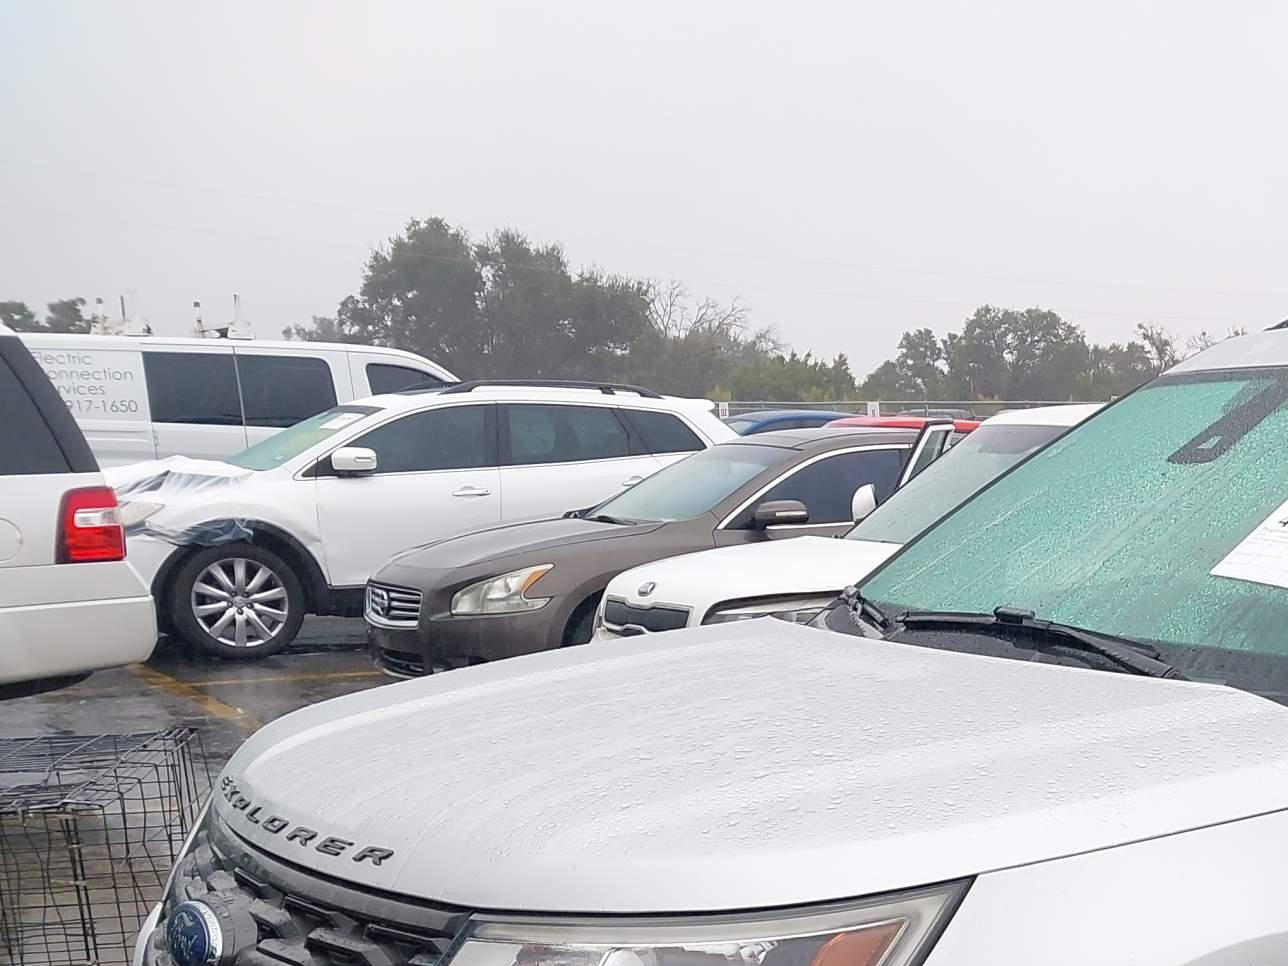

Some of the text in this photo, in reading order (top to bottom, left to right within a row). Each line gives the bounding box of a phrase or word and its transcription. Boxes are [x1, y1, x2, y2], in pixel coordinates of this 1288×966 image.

[47, 368, 134, 381] onnection
[57, 382, 106, 395] rvices
[221, 776, 395, 866] EXPLORER
